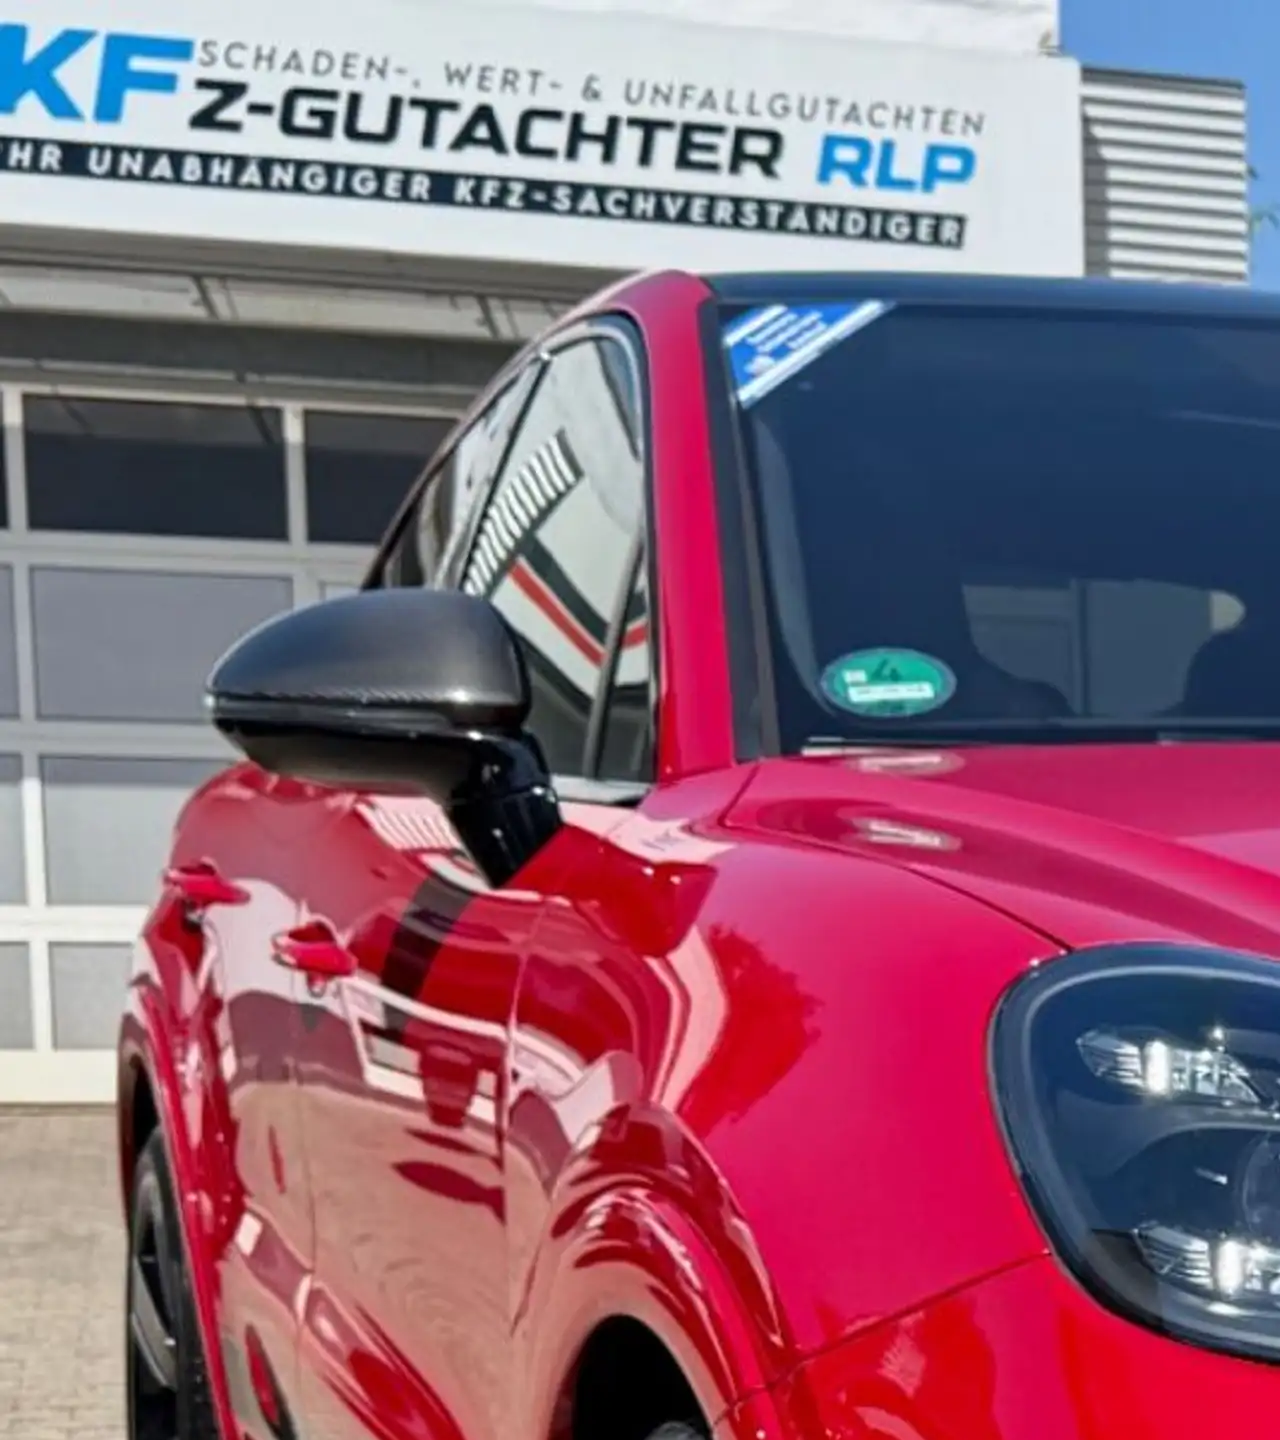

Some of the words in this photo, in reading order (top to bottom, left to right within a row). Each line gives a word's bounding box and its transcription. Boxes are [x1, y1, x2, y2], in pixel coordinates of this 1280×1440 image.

[445, 62, 562, 96] WERT-
[581, 74, 603, 102] &
[624, 79, 985, 135] UNFALLGUTACHTEN
[0, 141, 63, 171] HR
[189, 79, 783, 178] Z-GUTACHTER
[816, 134, 976, 193] RLP
